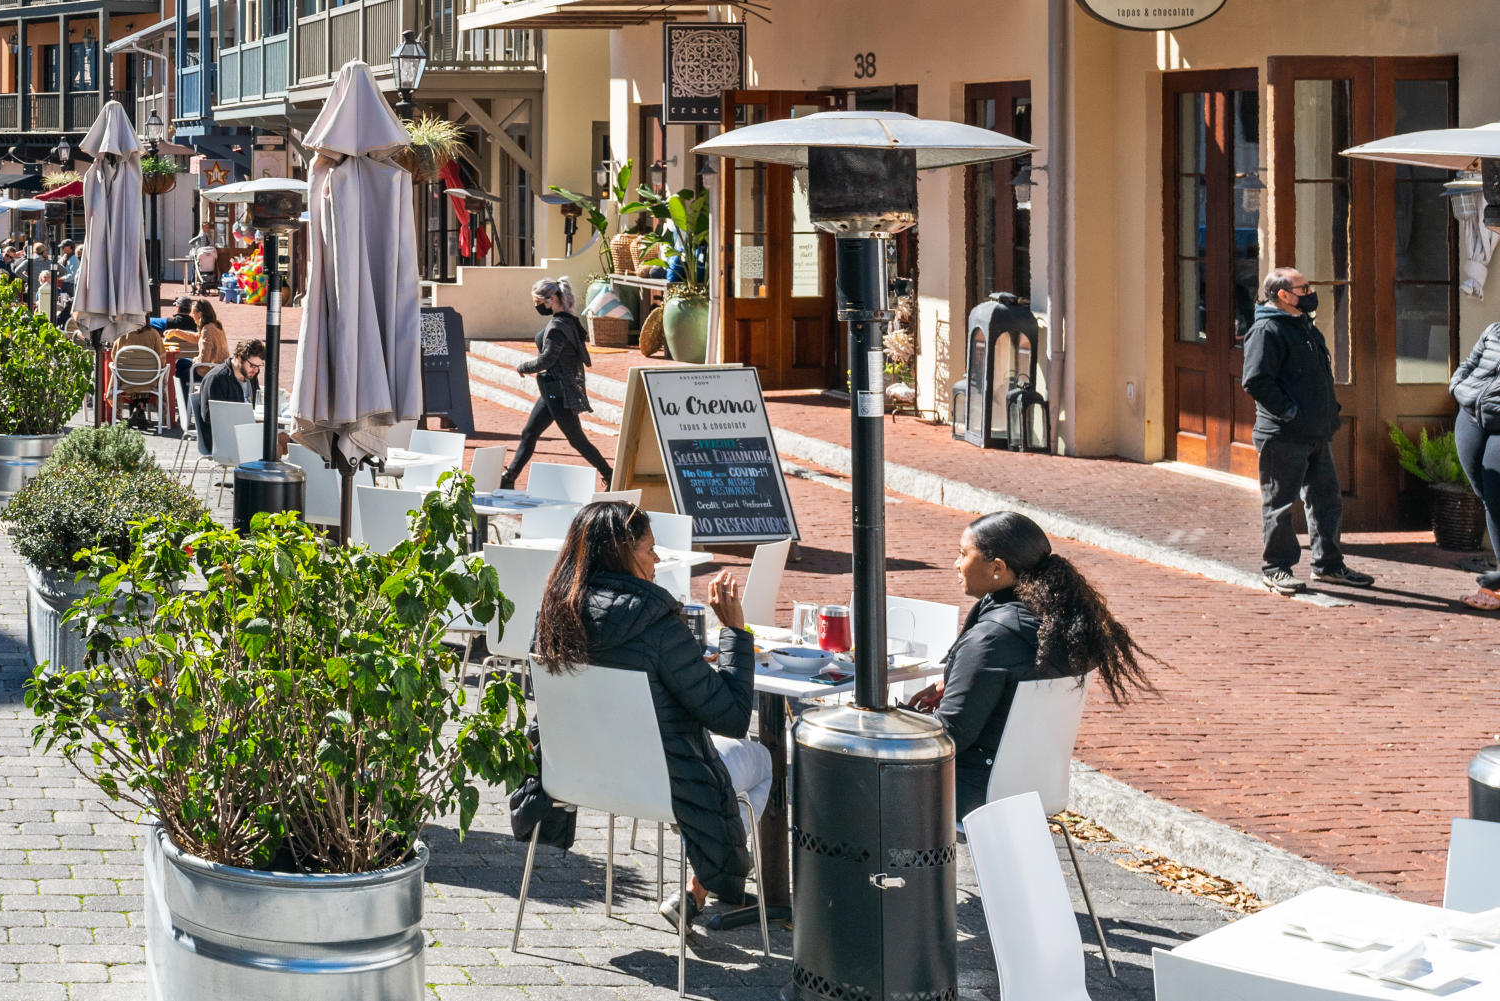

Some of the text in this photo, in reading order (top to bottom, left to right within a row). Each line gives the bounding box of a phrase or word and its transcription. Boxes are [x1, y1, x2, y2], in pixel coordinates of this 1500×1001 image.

[1117, 7, 1195, 18] tapas & chocolate
[854, 52, 877, 79] 38
[671, 107, 742, 117] tracey
[658, 396, 758, 415] la Crema
[680, 421, 747, 431] tapas & chocolate
[728, 467, 769, 477] COVID-19
[696, 501, 720, 510] Credit
[722, 500, 740, 509] Card
[693, 517, 712, 534] NO
